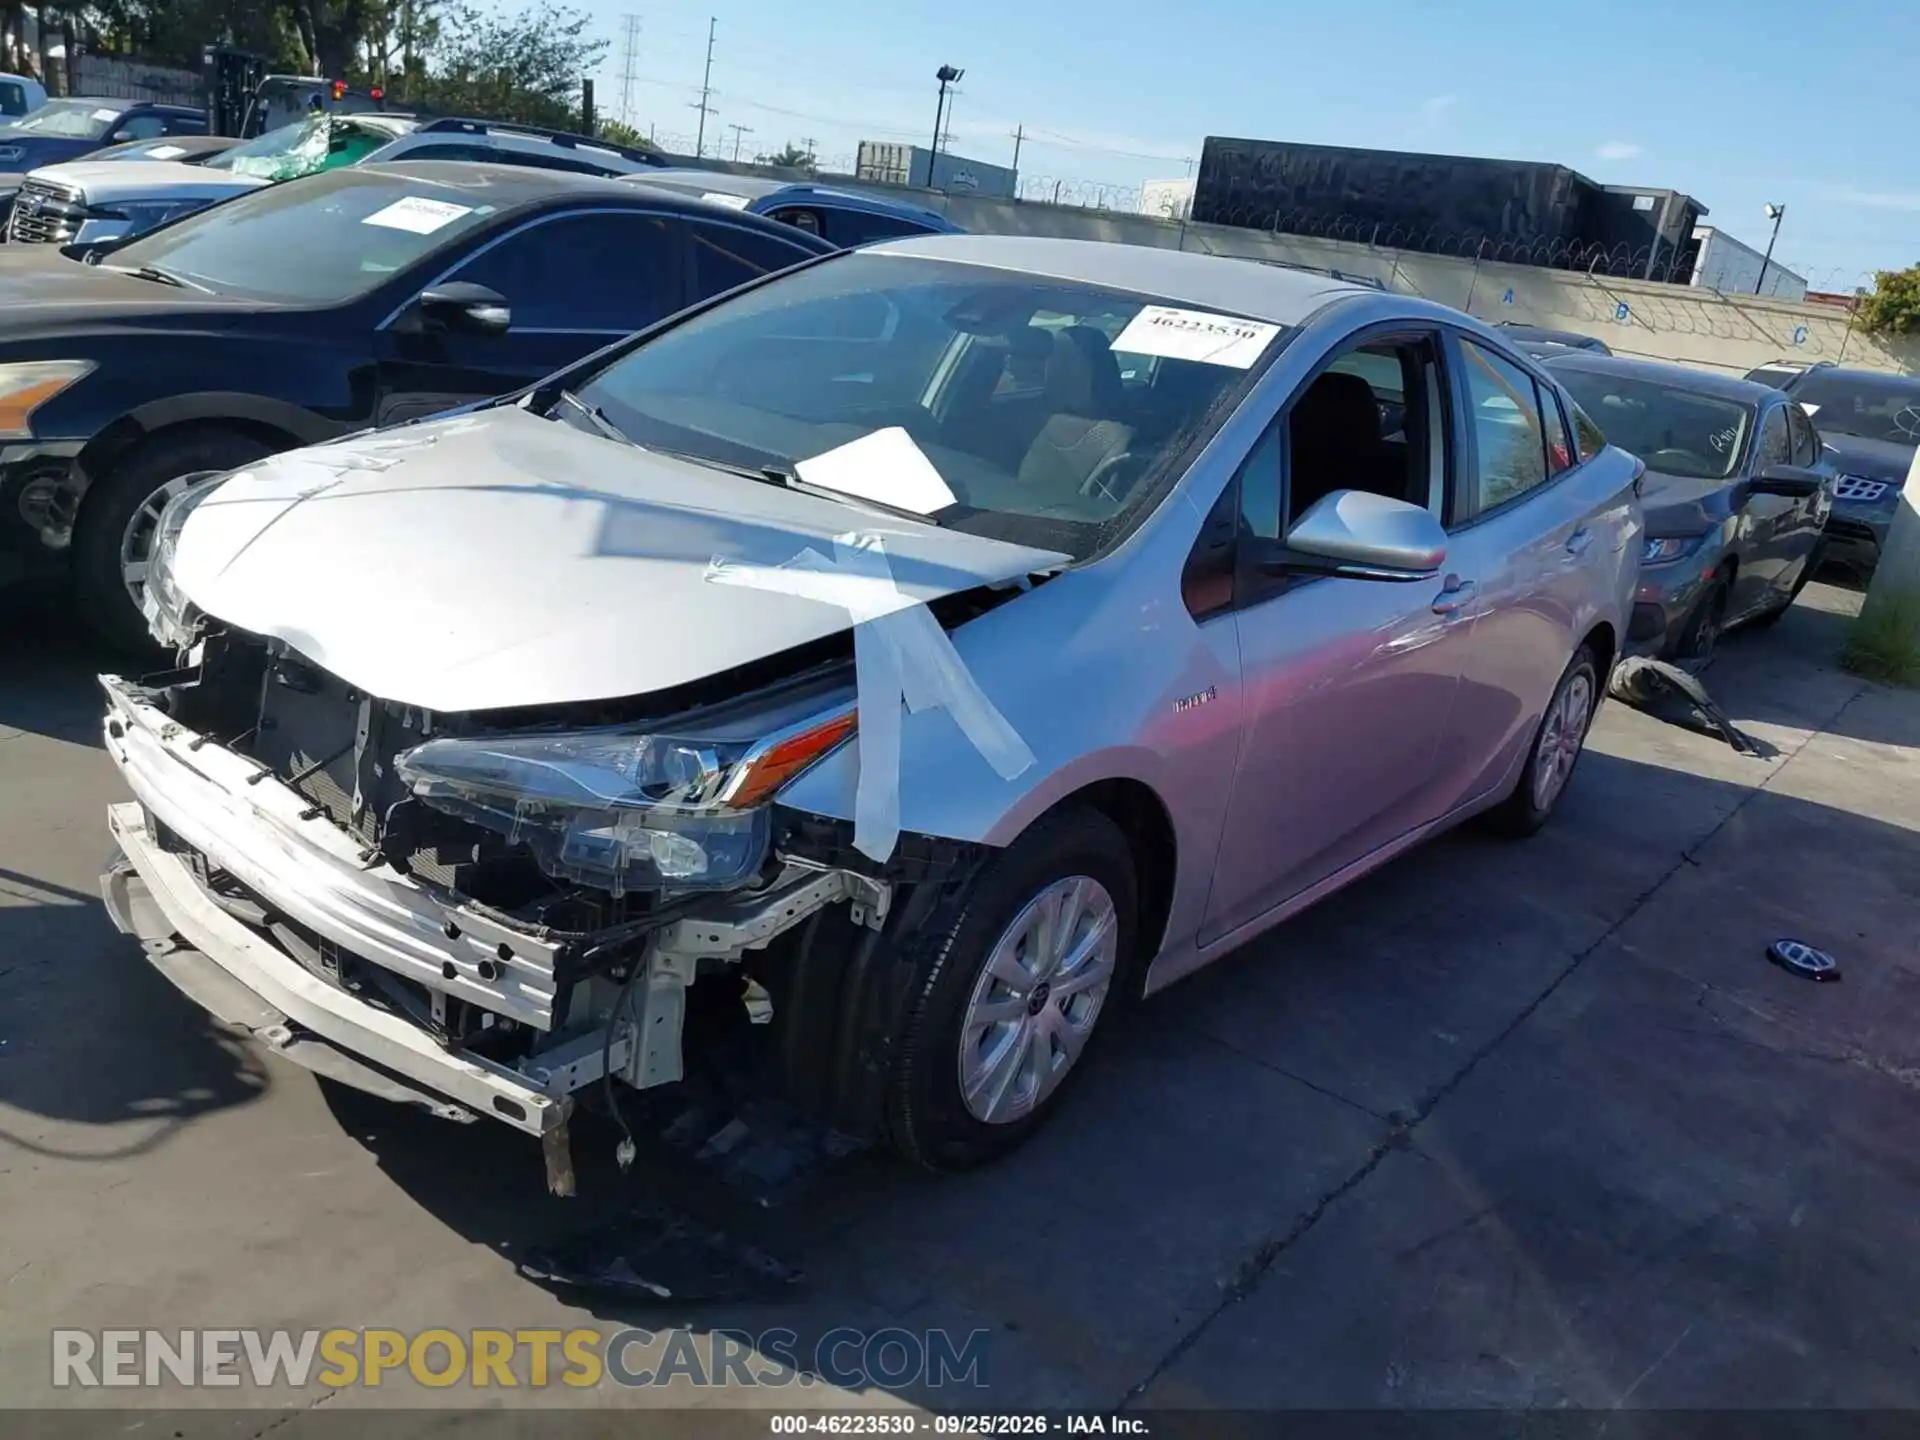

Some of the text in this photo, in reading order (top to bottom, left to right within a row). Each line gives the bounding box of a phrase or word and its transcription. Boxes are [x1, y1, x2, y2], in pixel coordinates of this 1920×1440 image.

[1502, 287, 1514, 304] A
[1615, 303, 1629, 320] B
[1148, 316, 1256, 340] 46223530
[1793, 326, 1809, 345] C
